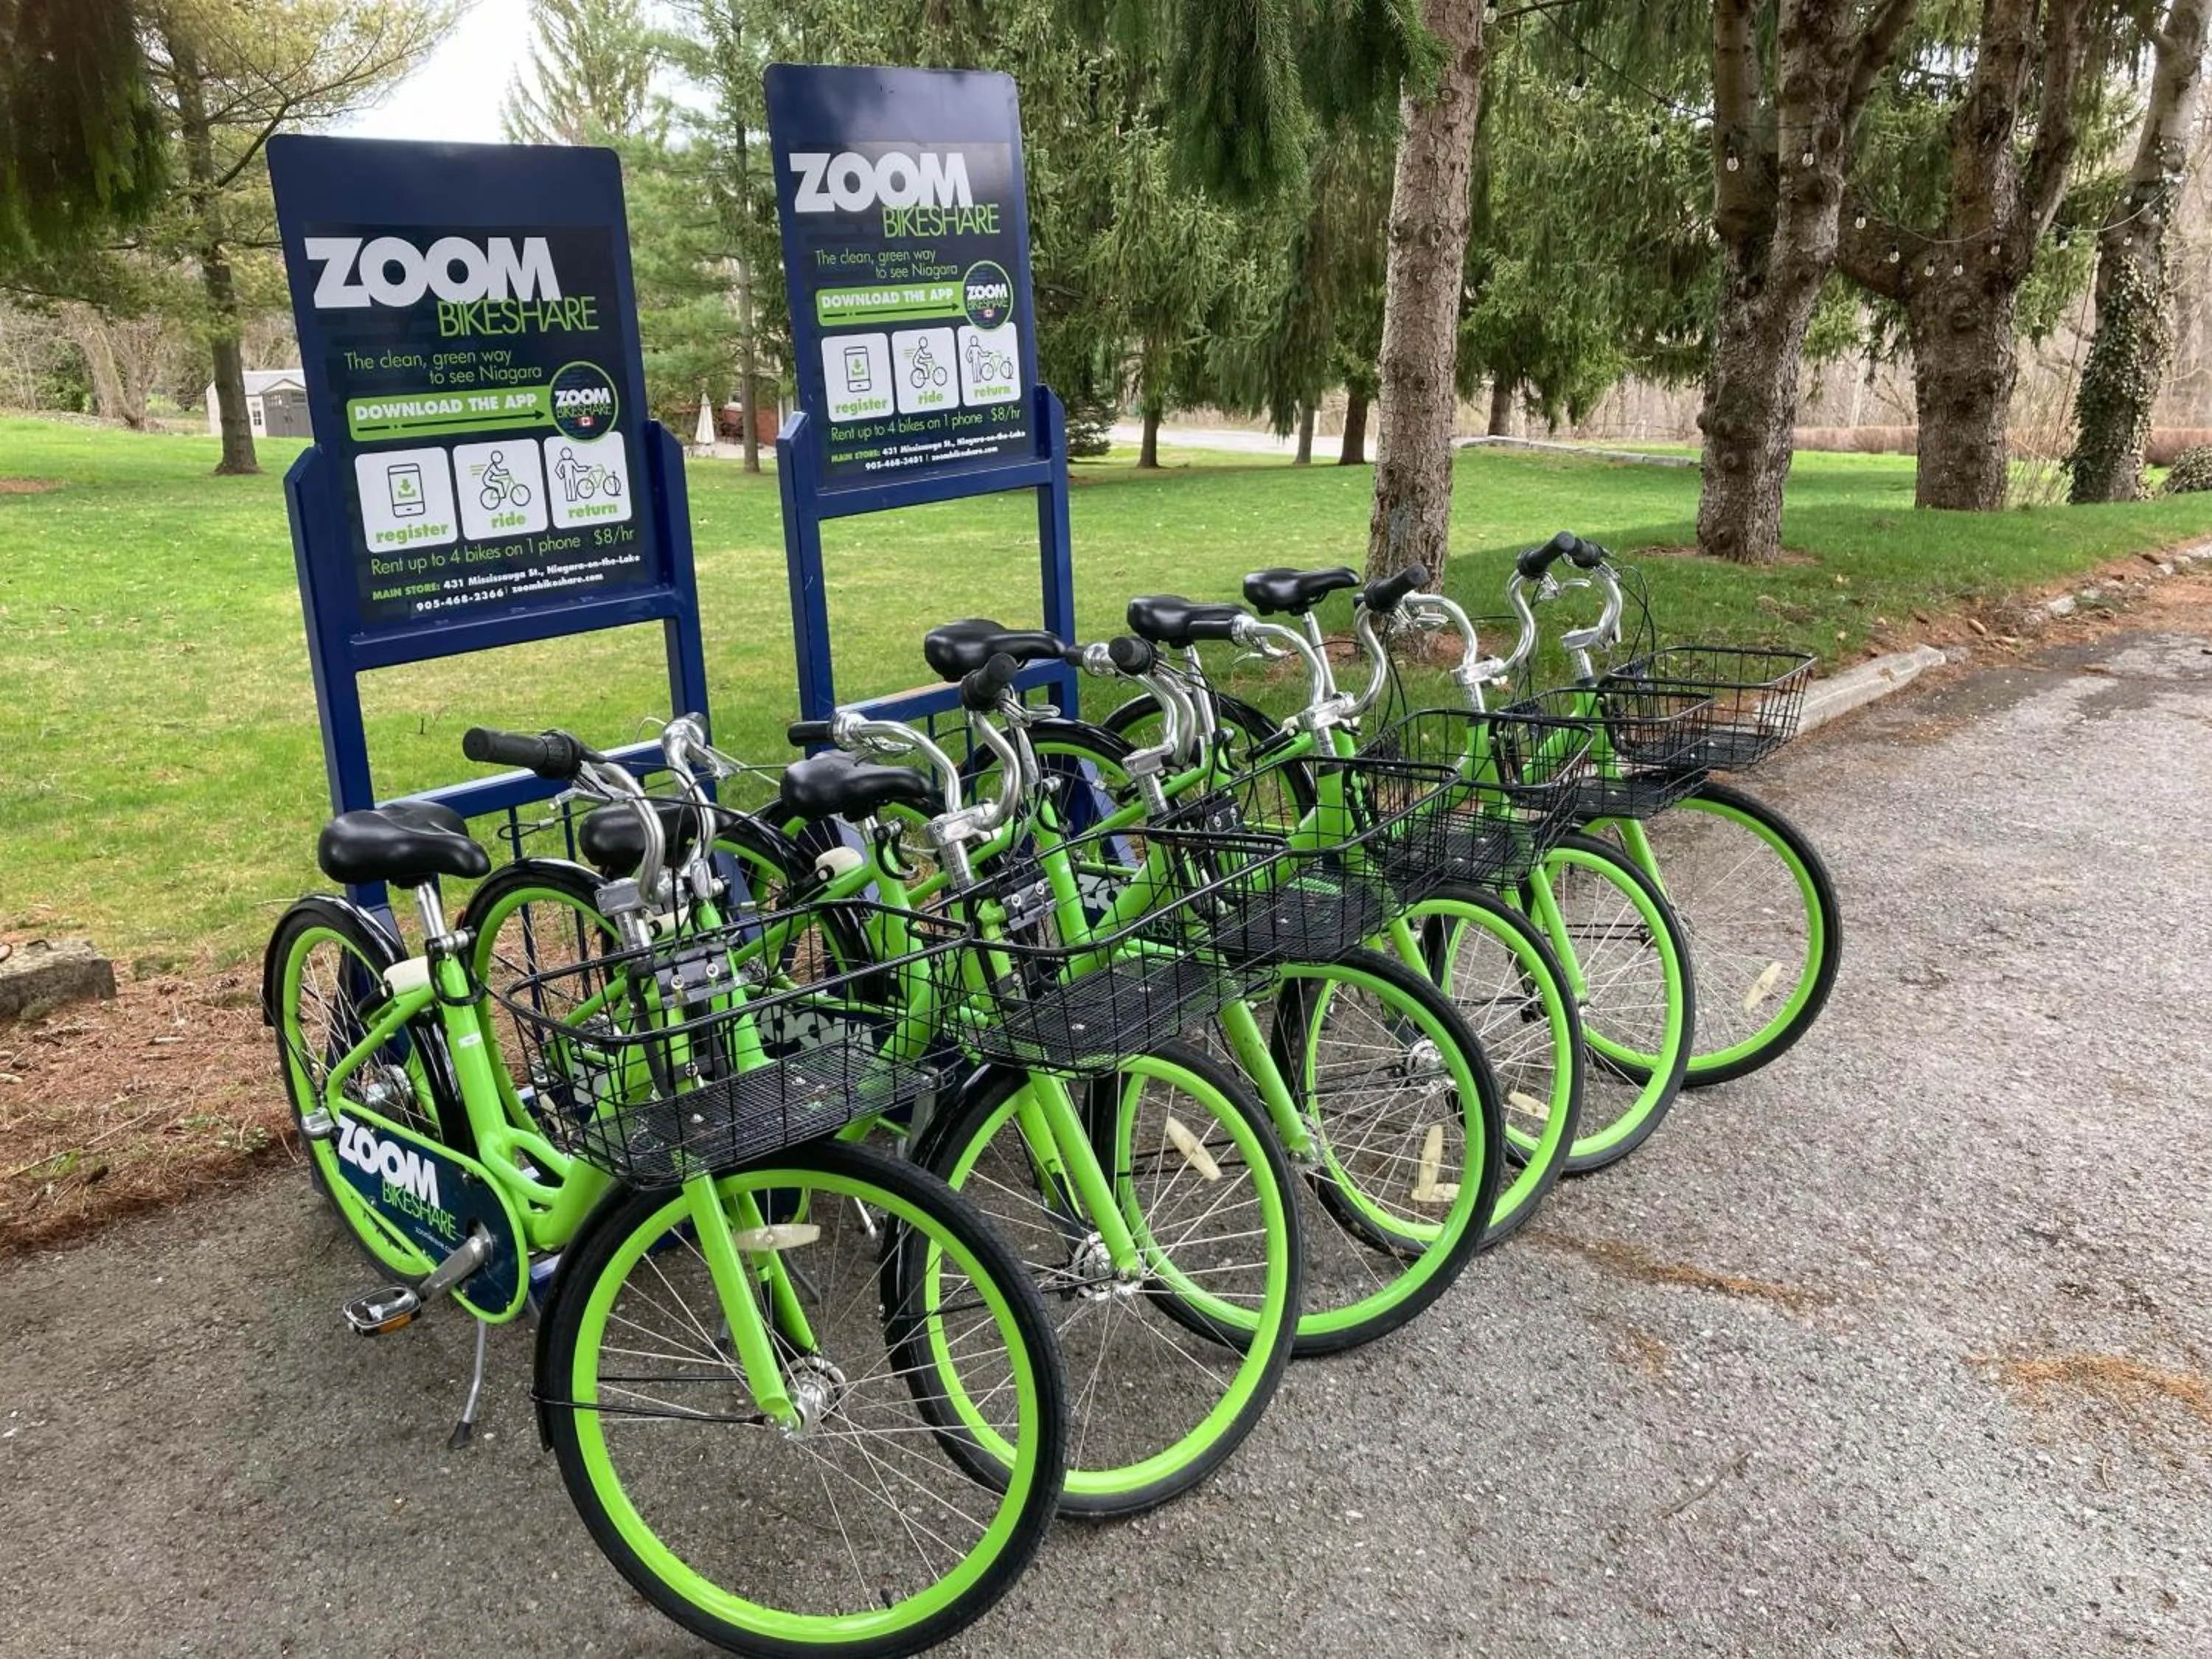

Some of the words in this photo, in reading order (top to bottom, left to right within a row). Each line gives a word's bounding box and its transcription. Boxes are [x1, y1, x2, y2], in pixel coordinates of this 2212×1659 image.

[789, 151, 974, 212] ZOOM
[882, 203, 1001, 238] BIKESHARE
[815, 250, 835, 266] The
[840, 248, 874, 265] clean,
[878, 251, 911, 266] green
[913, 249, 936, 261] way
[304, 236, 562, 308] ZOOM
[876, 267, 886, 279] to
[890, 268, 908, 278] see
[912, 263, 958, 279] Niagara
[821, 290, 900, 309] DOWNLOAD
[902, 291, 926, 303] THE
[930, 288, 955, 301] APP
[967, 283, 1008, 300] ZOOM
[437, 296, 599, 337] BIKESHARE
[344, 352, 374, 370] The
[380, 349, 427, 369] clean,
[433, 351, 476, 369] green
[480, 349, 512, 366] way
[429, 370, 444, 385] to
[449, 372, 476, 383] see
[479, 365, 542, 384] Niagara
[554, 387, 611, 408] ZOOM
[917, 390, 944, 404] ride
[973, 385, 1012, 398] return
[354, 399, 463, 421] DOWNLOAD
[467, 396, 499, 412] THE
[504, 393, 538, 409] APP
[835, 397, 888, 416] register
[831, 426, 855, 442] Rent
[858, 427, 872, 440] up
[874, 422, 886, 436] to
[888, 423, 896, 434] 4
[899, 417, 925, 434] bikes
[927, 418, 941, 430] on
[952, 411, 983, 430] phone
[991, 406, 1021, 422] $8/hr
[490, 511, 527, 529] ride
[567, 502, 619, 520] return
[375, 524, 449, 544] register
[371, 557, 403, 576] Rent
[408, 557, 428, 574] up
[432, 552, 445, 567] to
[450, 548, 460, 564] 4
[465, 544, 501, 563] bikes
[505, 544, 523, 557] on
[526, 538, 533, 554] 1
[538, 535, 581, 557] phone
[594, 524, 636, 546] $8/hr
[372, 588, 402, 601] MAIN
[406, 582, 441, 596] STORE:
[443, 578, 464, 590] 431
[468, 571, 526, 587] Mississauga
[416, 589, 504, 612] 905-468-2366
[338, 1114, 440, 1209] ZOOM
[383, 1179, 457, 1242] BIKESHARE
